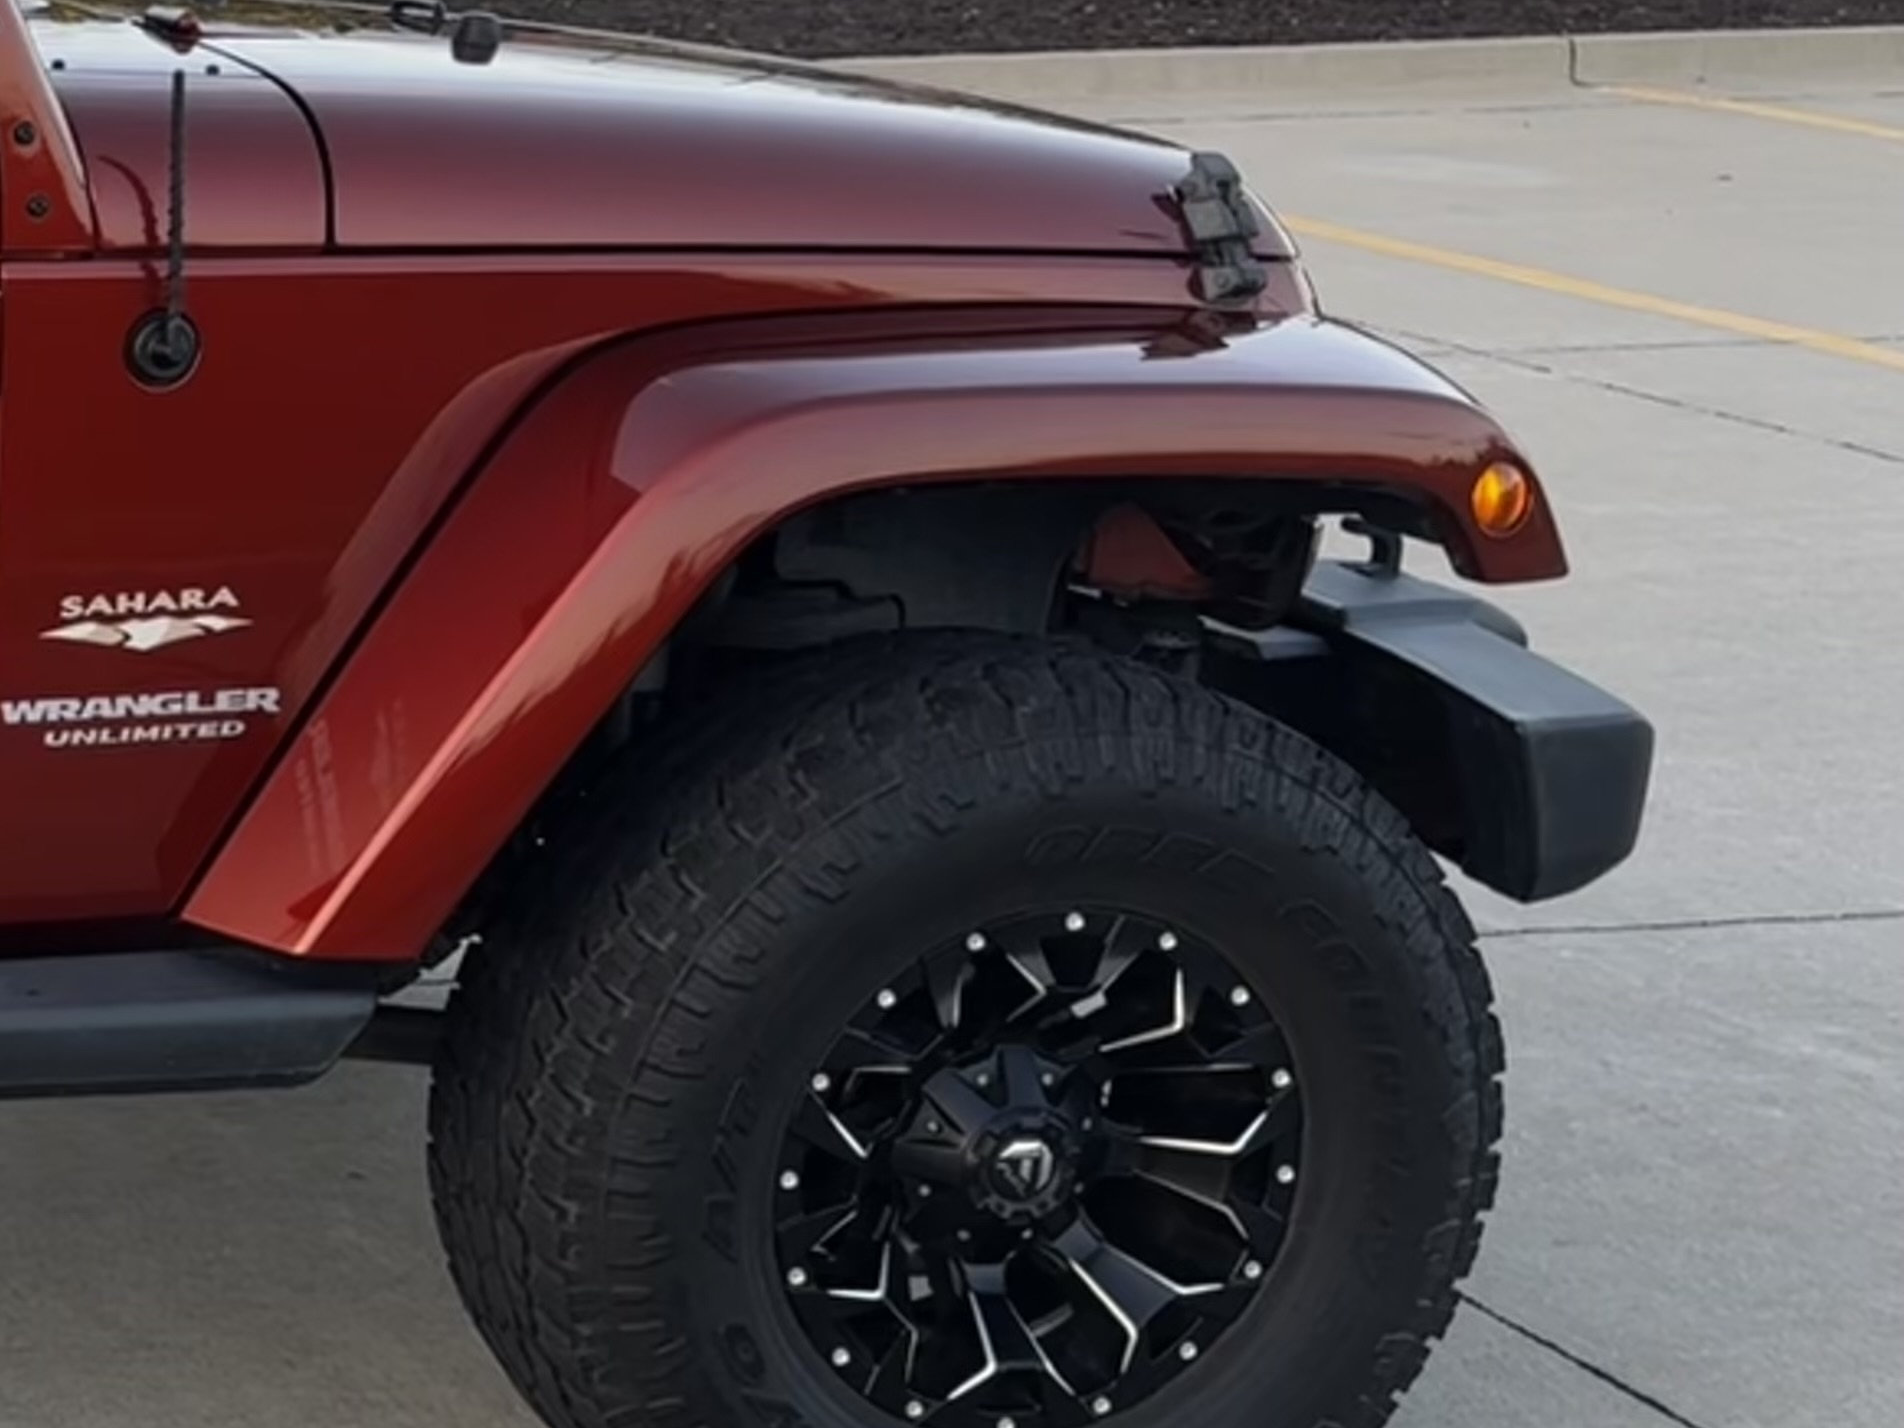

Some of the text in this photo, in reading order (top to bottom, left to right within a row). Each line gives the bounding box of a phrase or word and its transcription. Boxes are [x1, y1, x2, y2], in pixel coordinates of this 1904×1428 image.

[60, 586, 238, 617] SAHARA
[0, 687, 281, 724] WRANGLER
[43, 721, 245, 747] UNLIMITED
